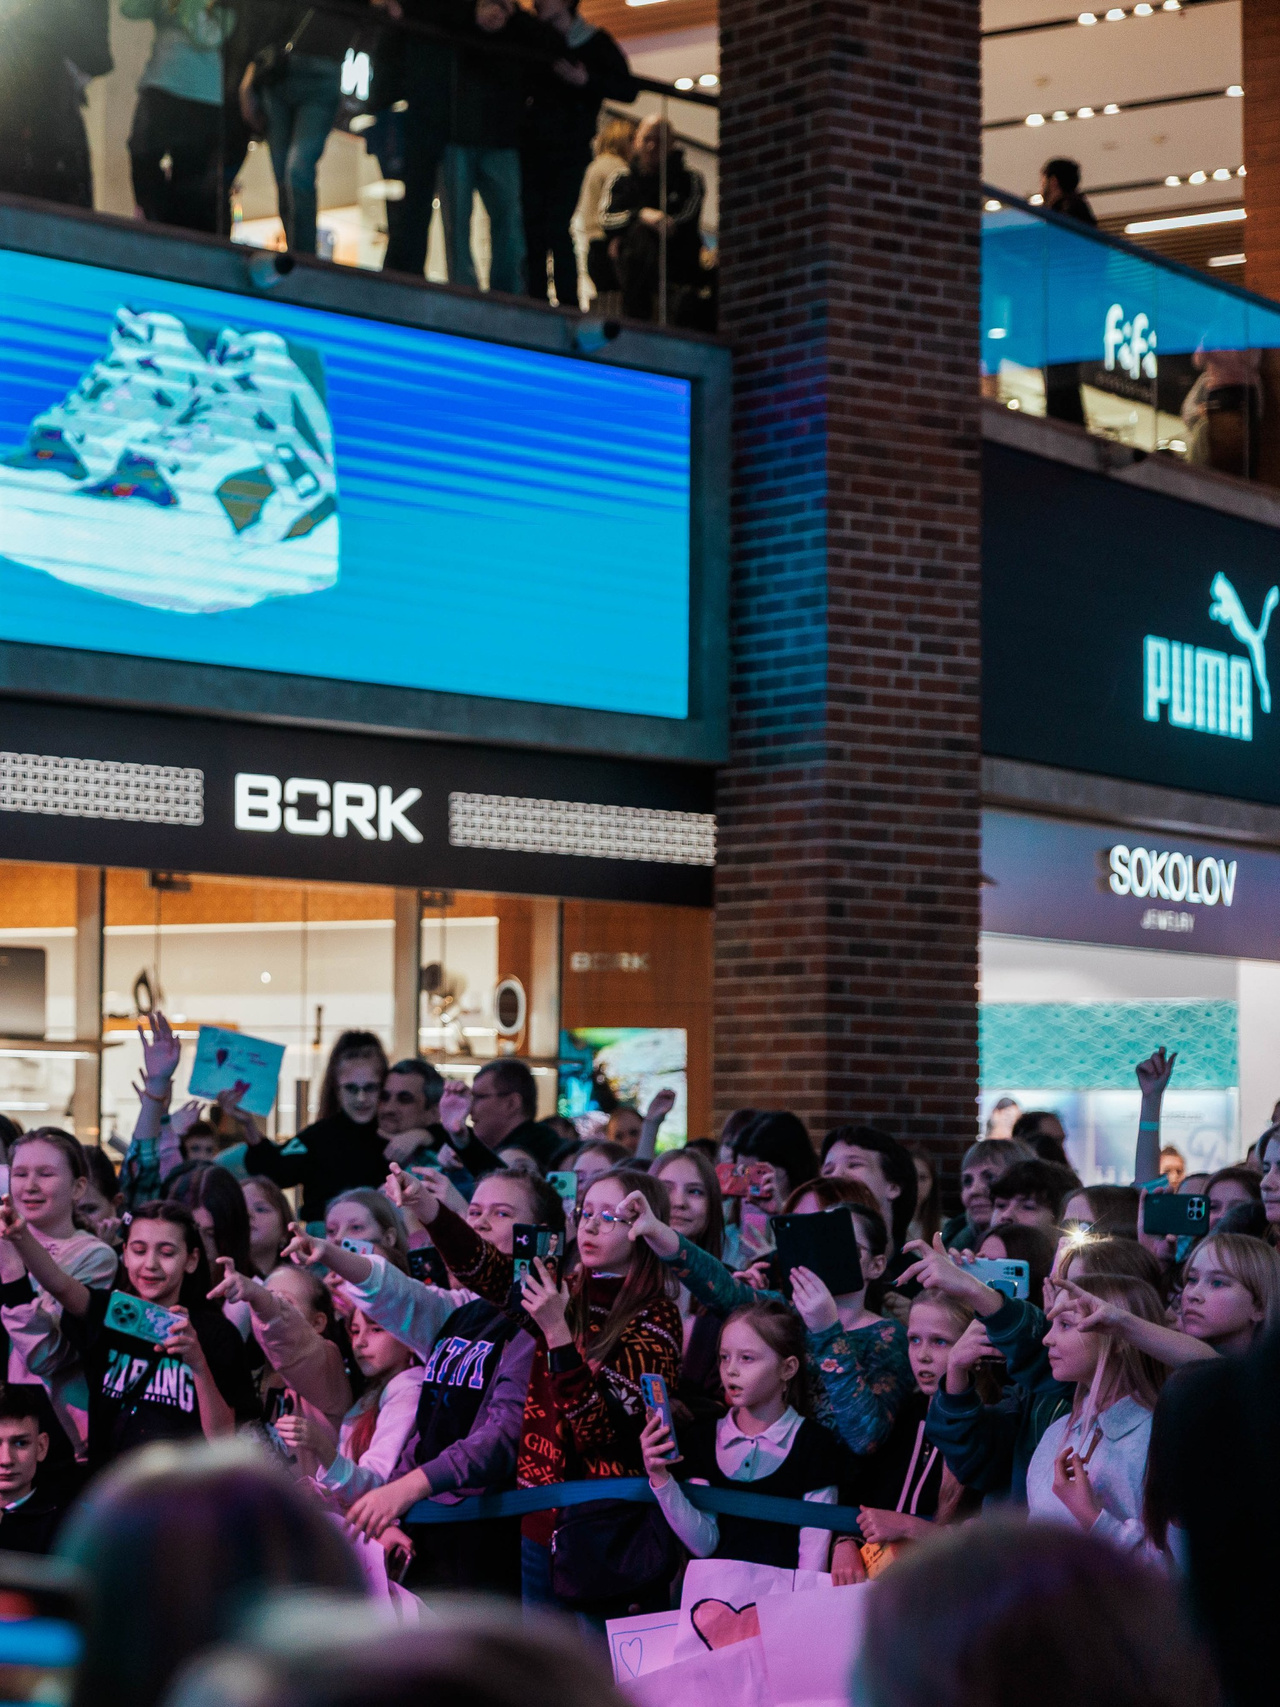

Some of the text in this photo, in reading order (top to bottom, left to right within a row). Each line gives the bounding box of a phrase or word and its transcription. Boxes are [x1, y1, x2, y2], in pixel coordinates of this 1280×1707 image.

[1143, 634, 1253, 742] PUMA
[235, 773, 424, 843] BORK
[1109, 845, 1237, 907] SOKOLOV
